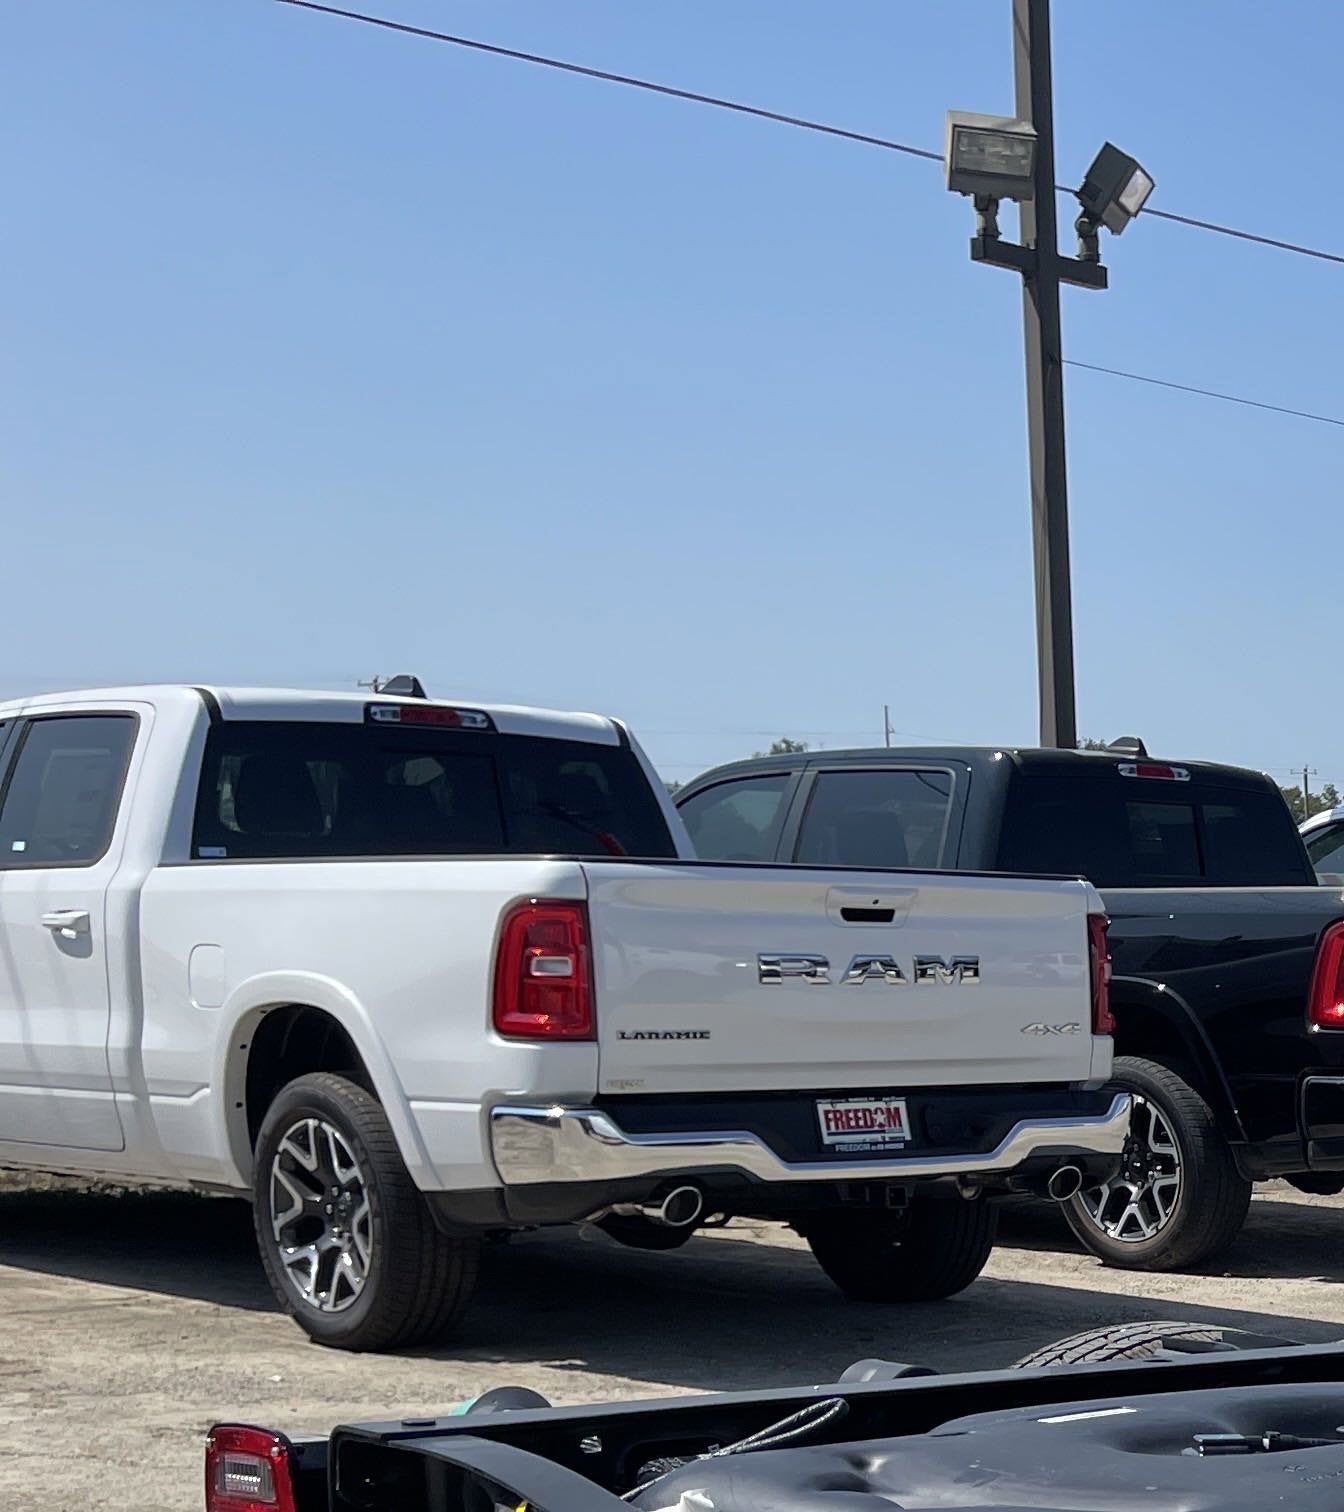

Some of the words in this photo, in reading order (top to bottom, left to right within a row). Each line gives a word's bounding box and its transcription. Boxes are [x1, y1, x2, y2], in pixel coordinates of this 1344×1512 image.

[756, 953, 981, 985] RAM
[616, 1030, 711, 1041] LARAMIE
[823, 1106, 902, 1131] FREEDOM
